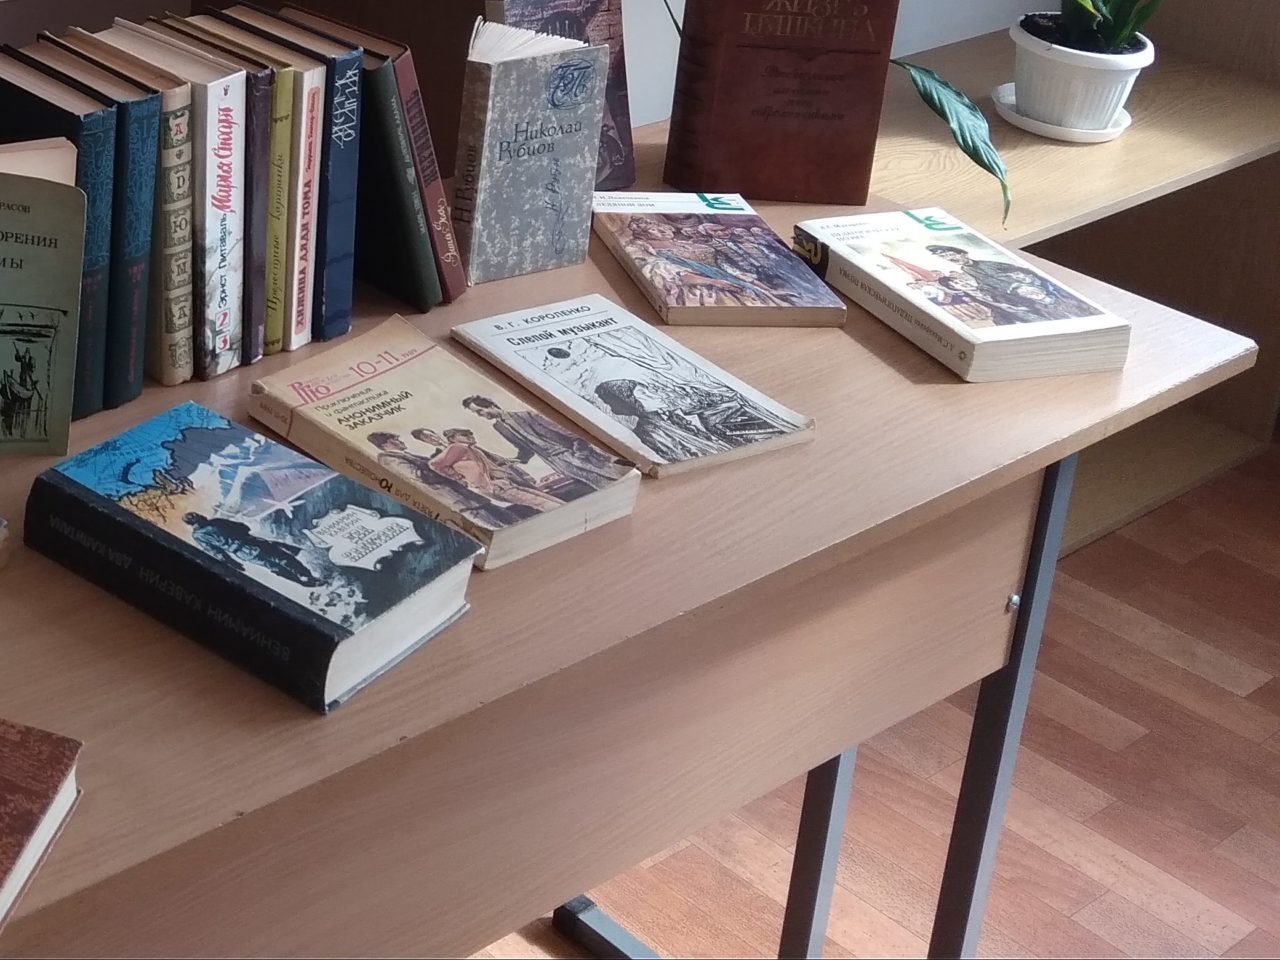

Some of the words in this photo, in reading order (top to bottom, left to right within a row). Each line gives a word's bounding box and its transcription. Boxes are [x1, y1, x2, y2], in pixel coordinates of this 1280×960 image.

[513, 121, 582, 144] Николай
[497, 140, 555, 165] Рубцов
[210, 161, 236, 213] Мария
[301, 178, 313, 219] ТОМА
[217, 213, 229, 268] Питаваль
[298, 222, 311, 262] ДЯДИ
[266, 234, 282, 312] Прелестные
[218, 273, 229, 308] Эрнст
[296, 266, 308, 327] ХИЖИНА
[506, 330, 557, 347] Слепой
[558, 317, 618, 342] музыкант
[522, 305, 591, 325] КОРОЛЕНКО
[314, 388, 373, 412] Приключения
[333, 390, 389, 417] фантастика
[337, 391, 413, 425] АНОНИМНЫЙ
[344, 405, 407, 431] ЗАКАЗЧИК
